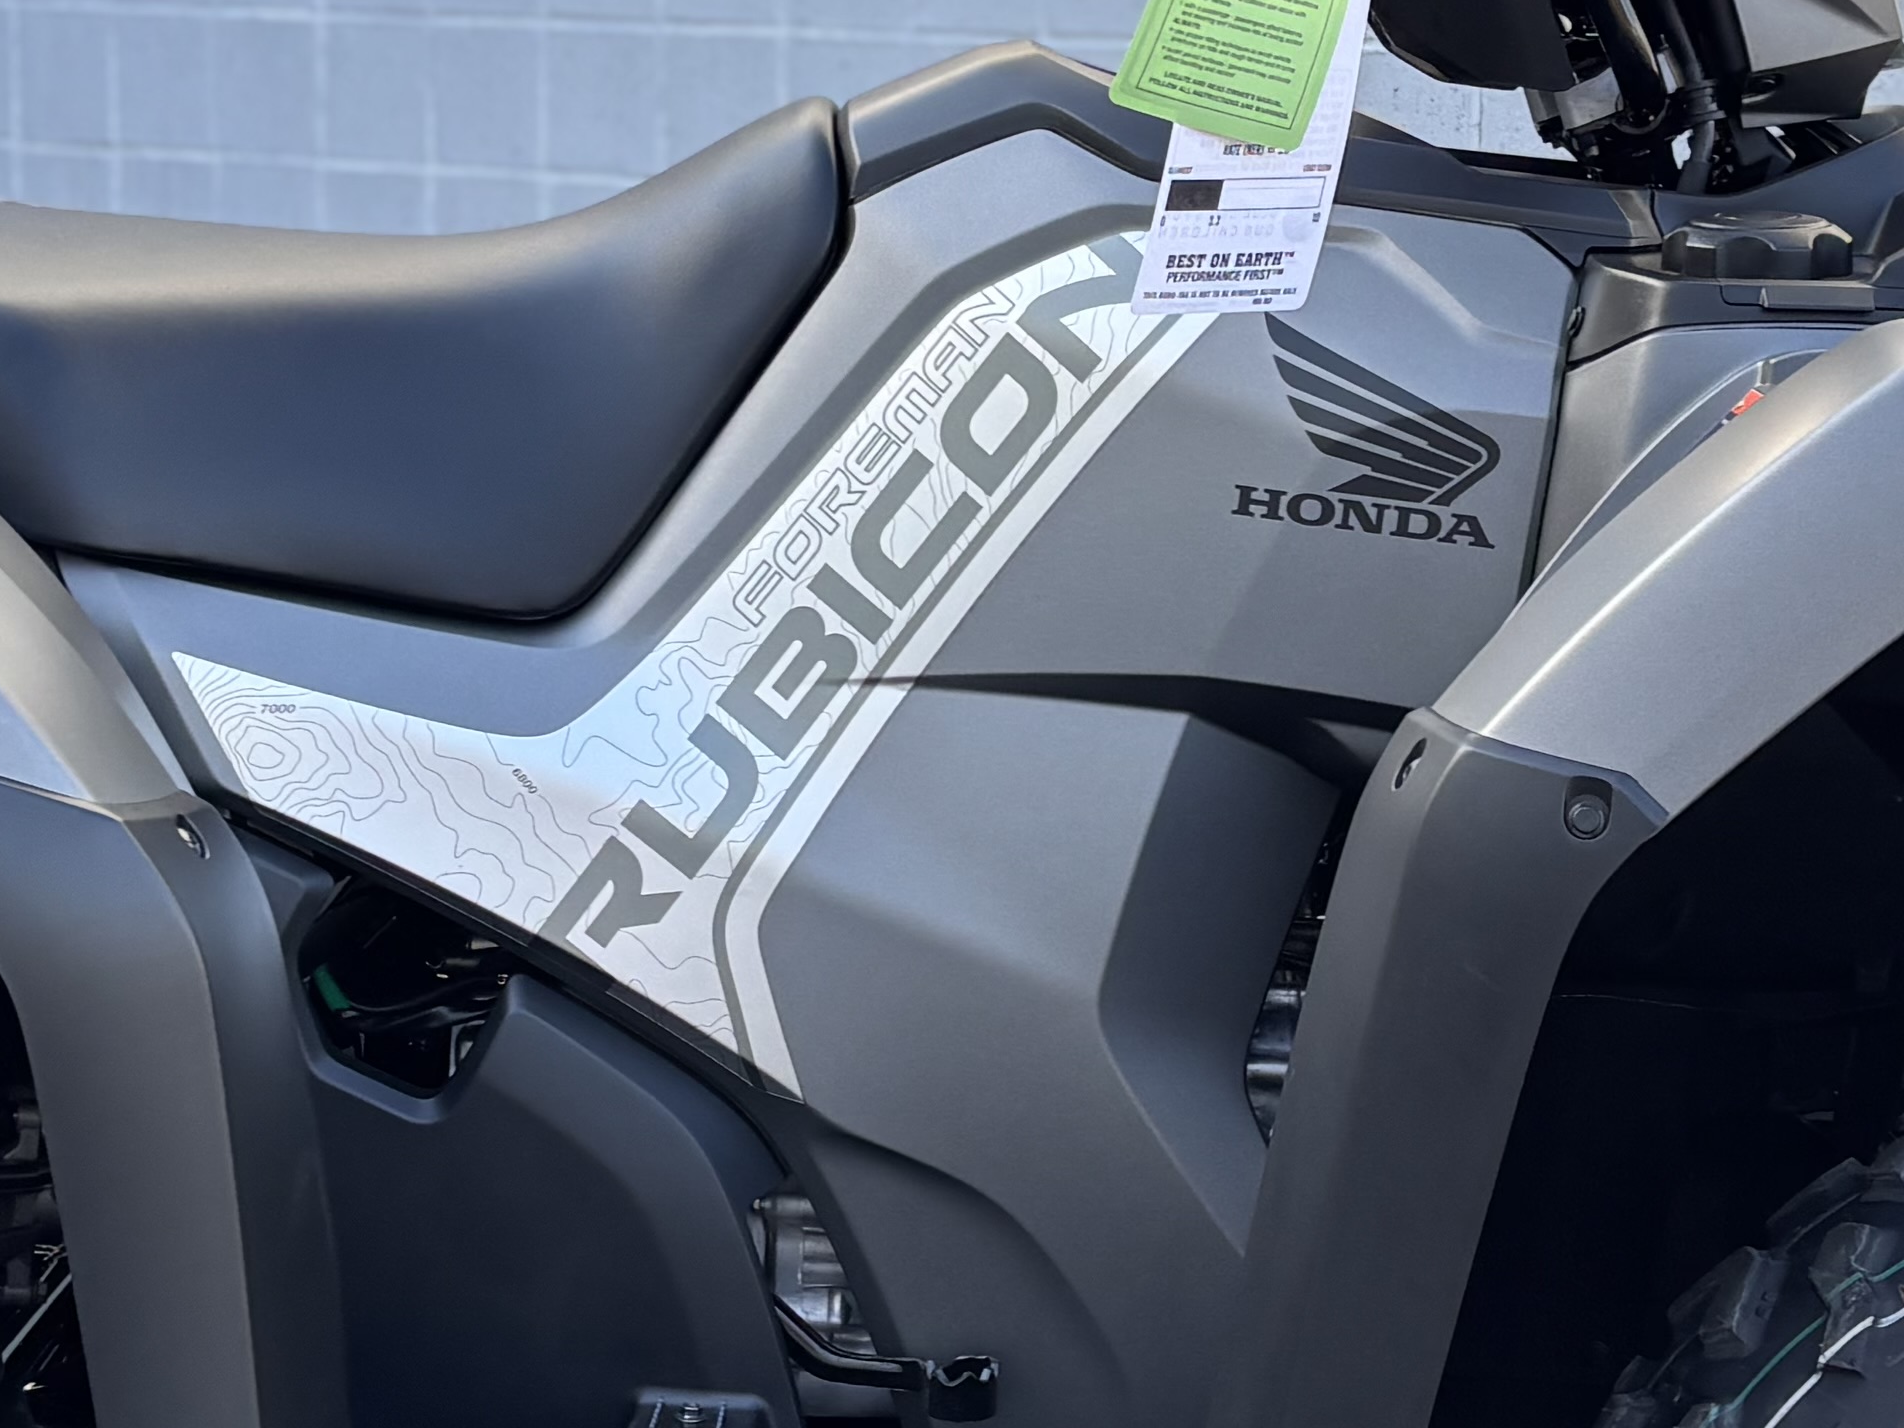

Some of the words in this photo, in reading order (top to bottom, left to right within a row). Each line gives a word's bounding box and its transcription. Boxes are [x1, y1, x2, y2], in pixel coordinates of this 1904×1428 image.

[1166, 254, 1207, 269] BEST
[1210, 253, 1231, 268] ON
[1166, 270, 1242, 284] PERFORMANCE
[732, 286, 1015, 629] FOREMAN
[1231, 484, 1495, 549] HONDA
[538, 233, 1144, 948] RUBICON
[260, 703, 297, 714] 7000
